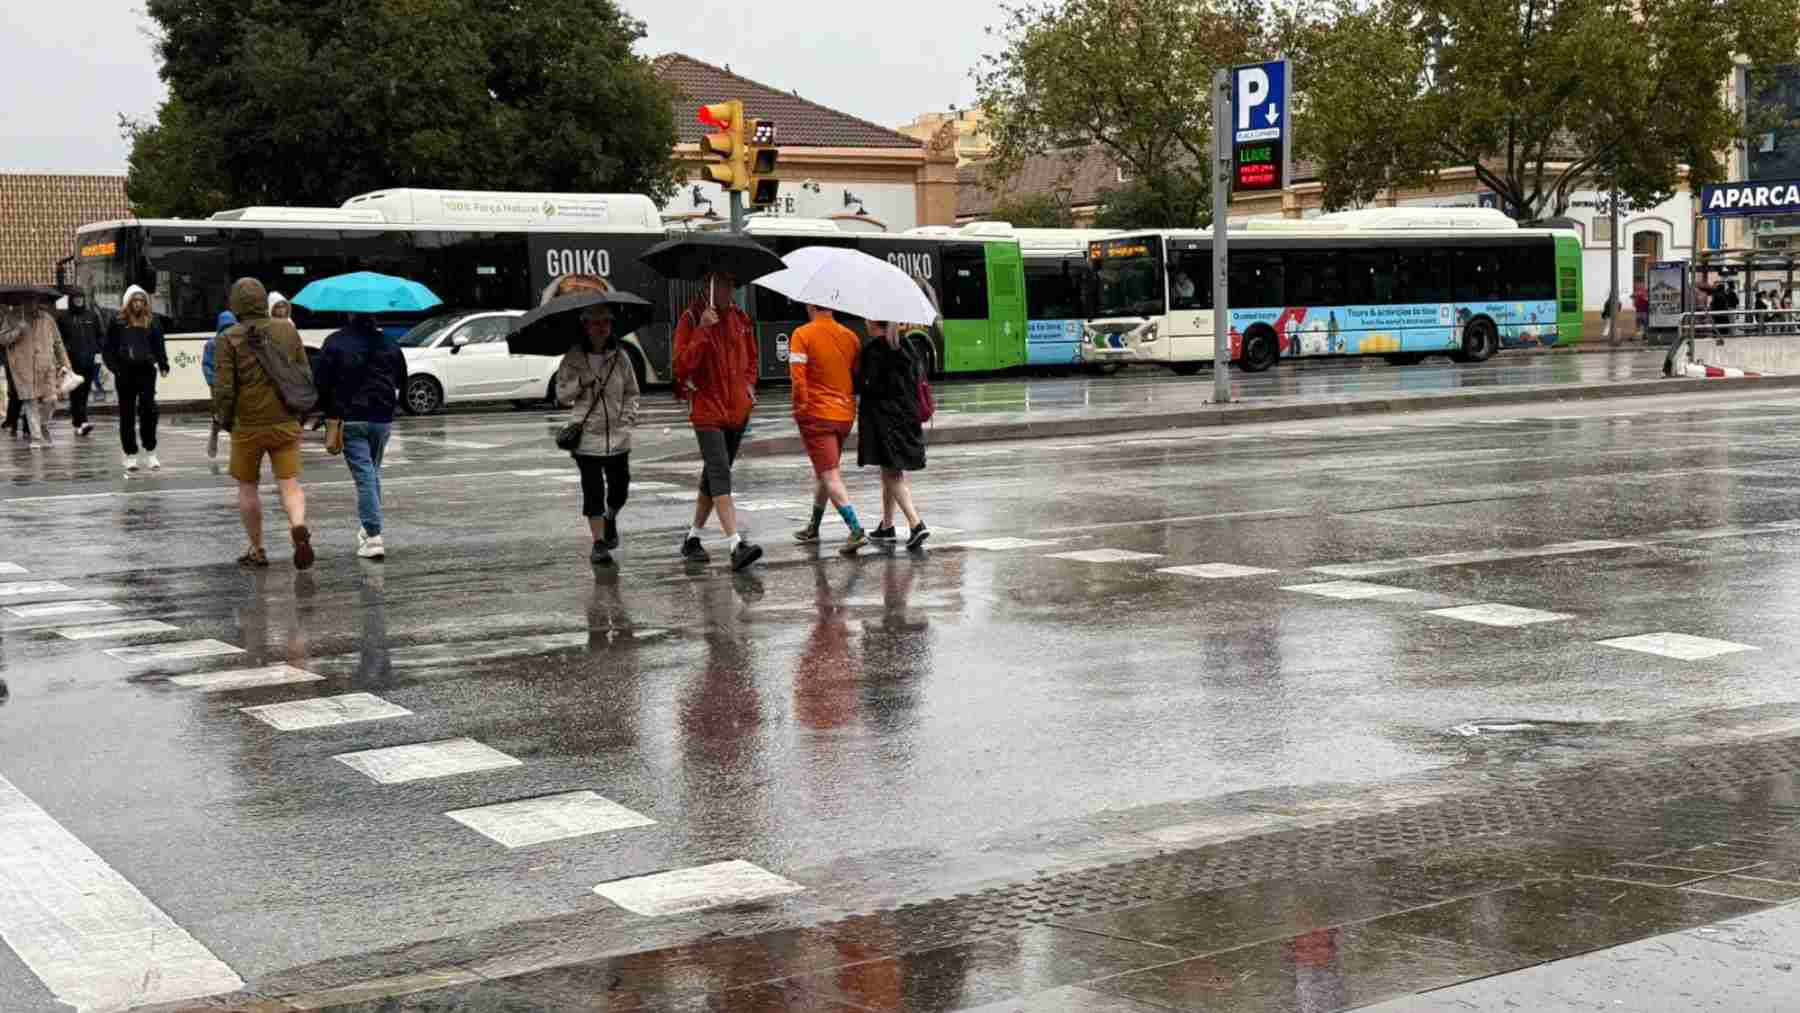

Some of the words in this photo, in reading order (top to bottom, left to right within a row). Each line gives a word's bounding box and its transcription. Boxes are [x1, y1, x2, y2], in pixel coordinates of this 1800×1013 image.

[1239, 68, 1269, 128] P
[1709, 185, 1800, 208] APARCA
[546, 249, 610, 277] GOIKO
